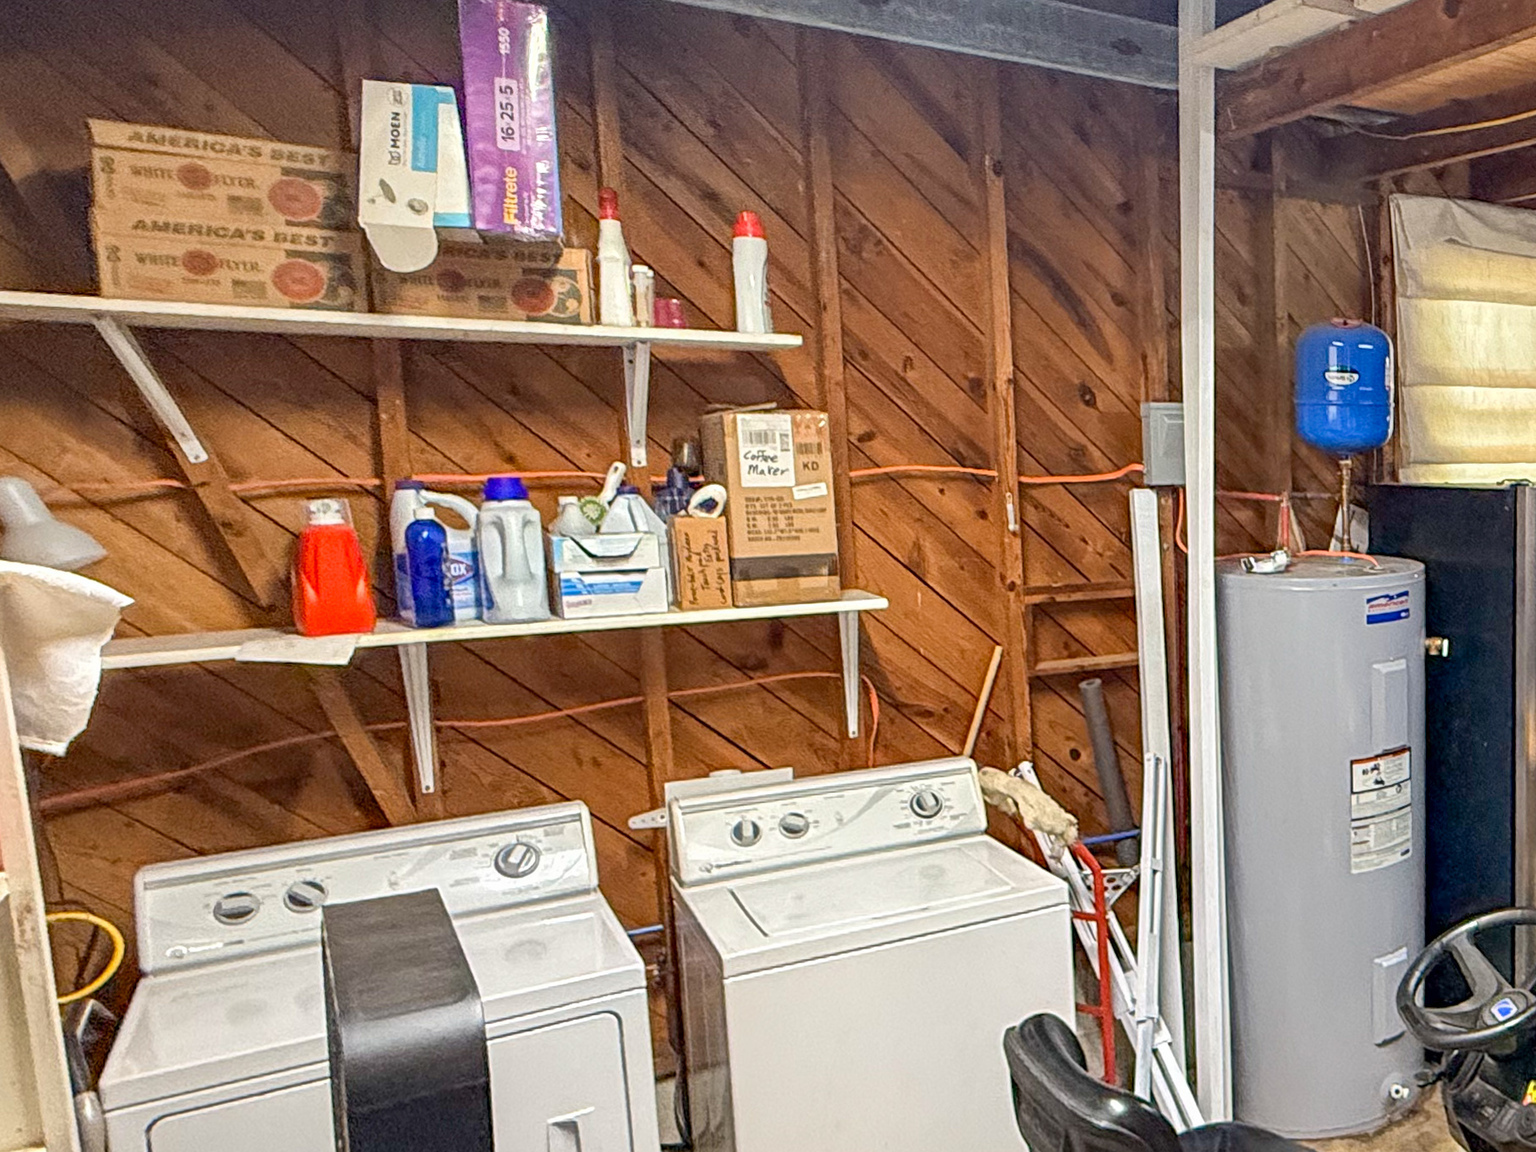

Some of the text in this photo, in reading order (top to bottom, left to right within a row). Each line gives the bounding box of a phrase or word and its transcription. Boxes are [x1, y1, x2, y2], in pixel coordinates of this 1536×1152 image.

[390, 111, 401, 149] MOEN
[128, 130, 333, 168] AMERICA'S BEST
[503, 166, 519, 225] Filtrete
[132, 219, 336, 248] AMERICA'S BEST
[747, 464, 790, 477] Maker
[802, 461, 820, 471] KD
